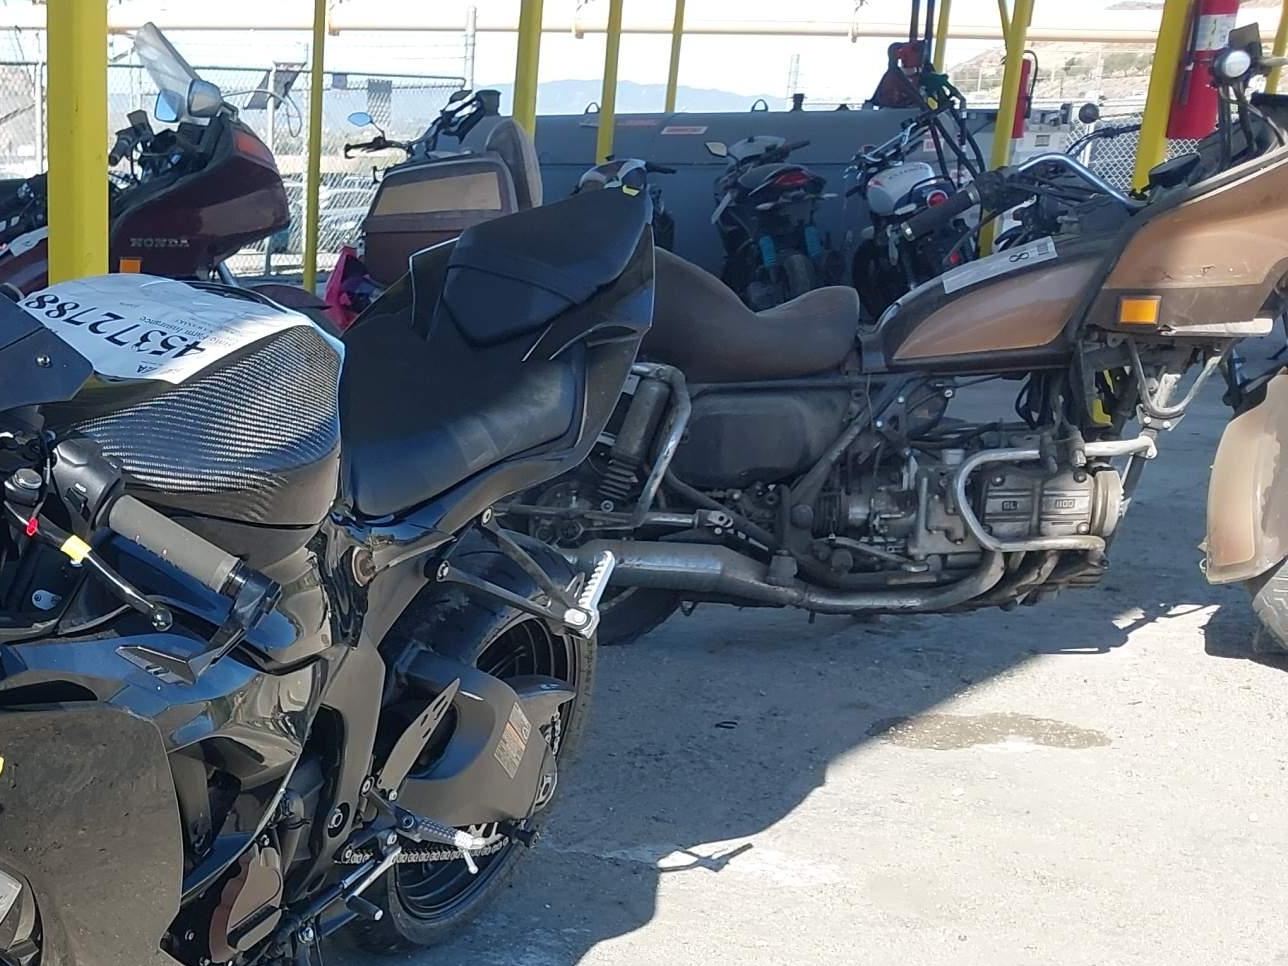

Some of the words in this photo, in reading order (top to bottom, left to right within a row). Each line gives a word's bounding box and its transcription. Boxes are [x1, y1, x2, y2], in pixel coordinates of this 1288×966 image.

[129, 237, 190, 248] HONDA
[25, 294, 206, 359] 45372788
[139, 315, 183, 333] Insurance
[184, 329, 209, 341] Farm
